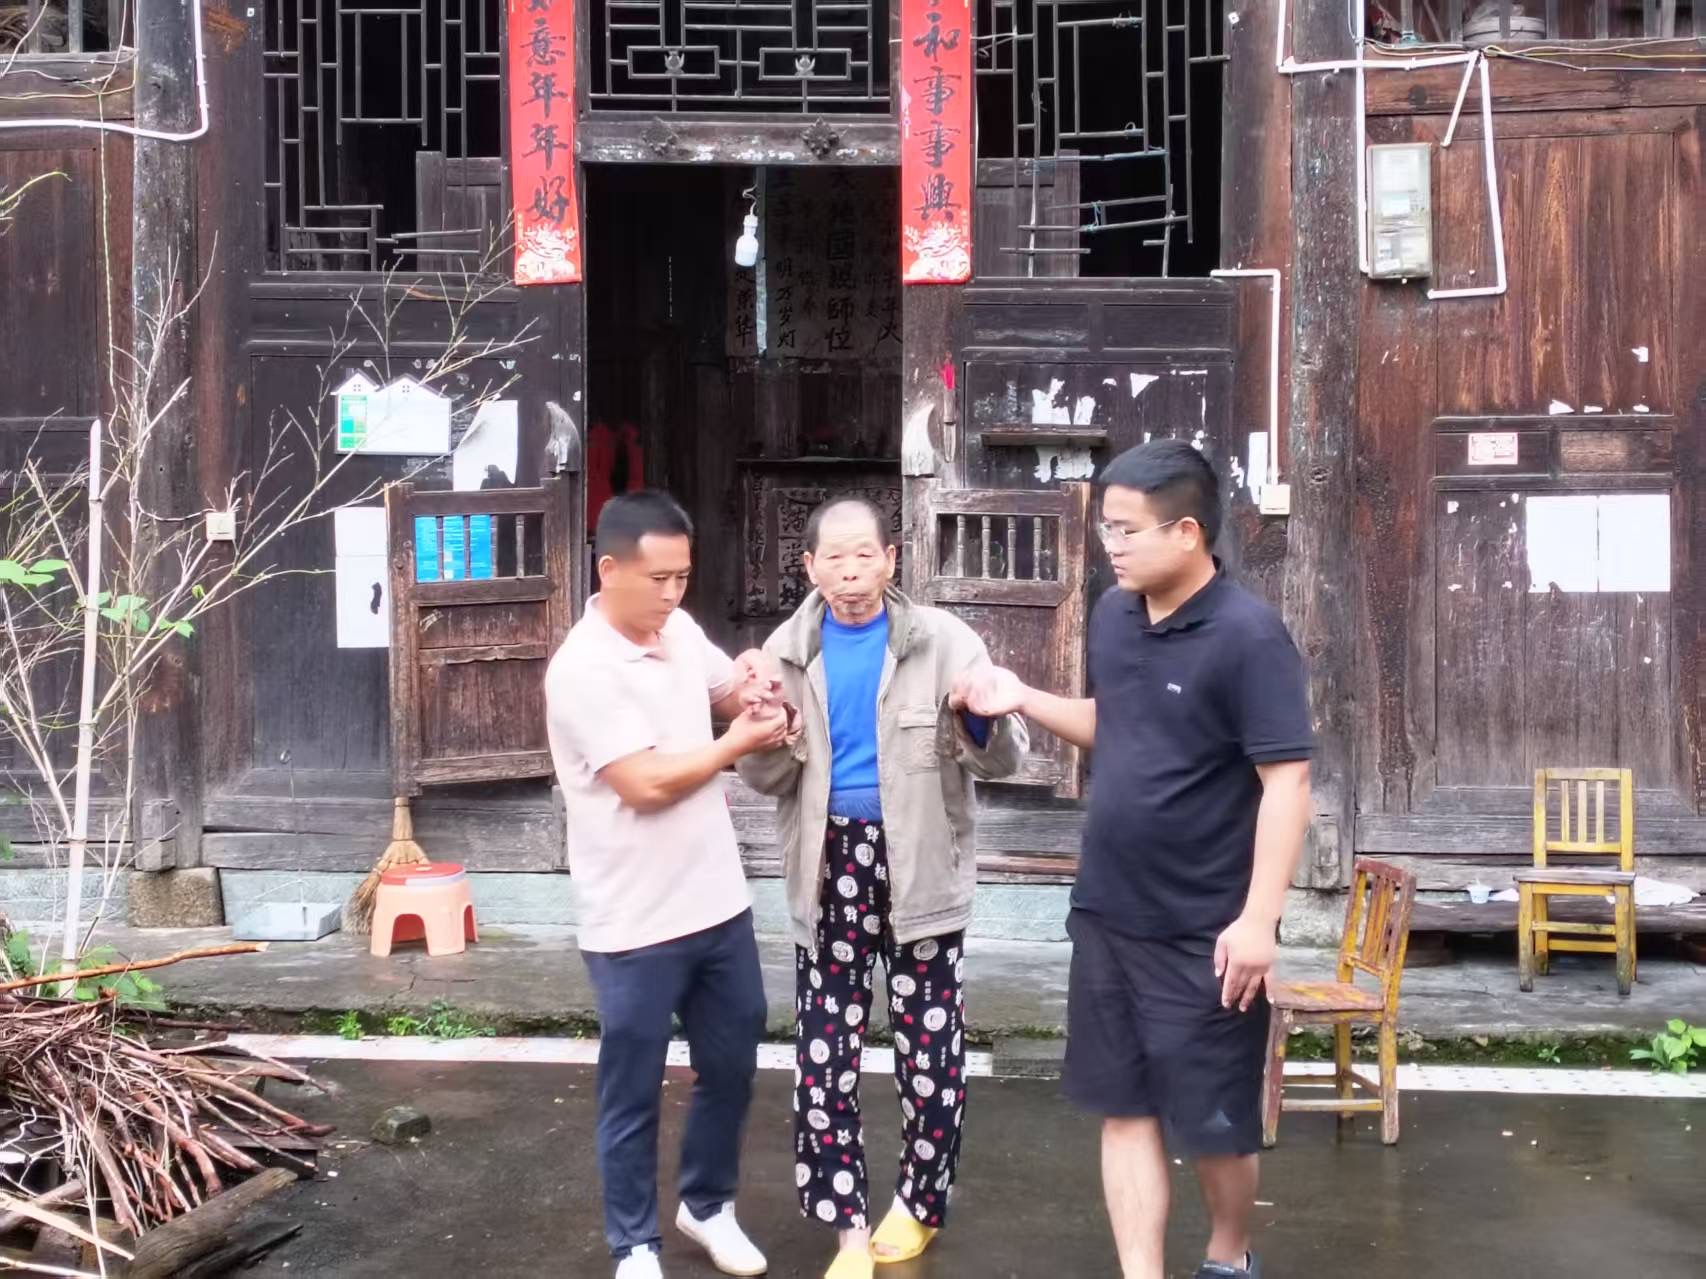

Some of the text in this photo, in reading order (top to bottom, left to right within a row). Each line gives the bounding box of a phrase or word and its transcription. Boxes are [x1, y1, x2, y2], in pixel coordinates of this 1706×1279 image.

[520, 0, 569, 224] 意年年好
[913, 0, 961, 222] 和事事興
